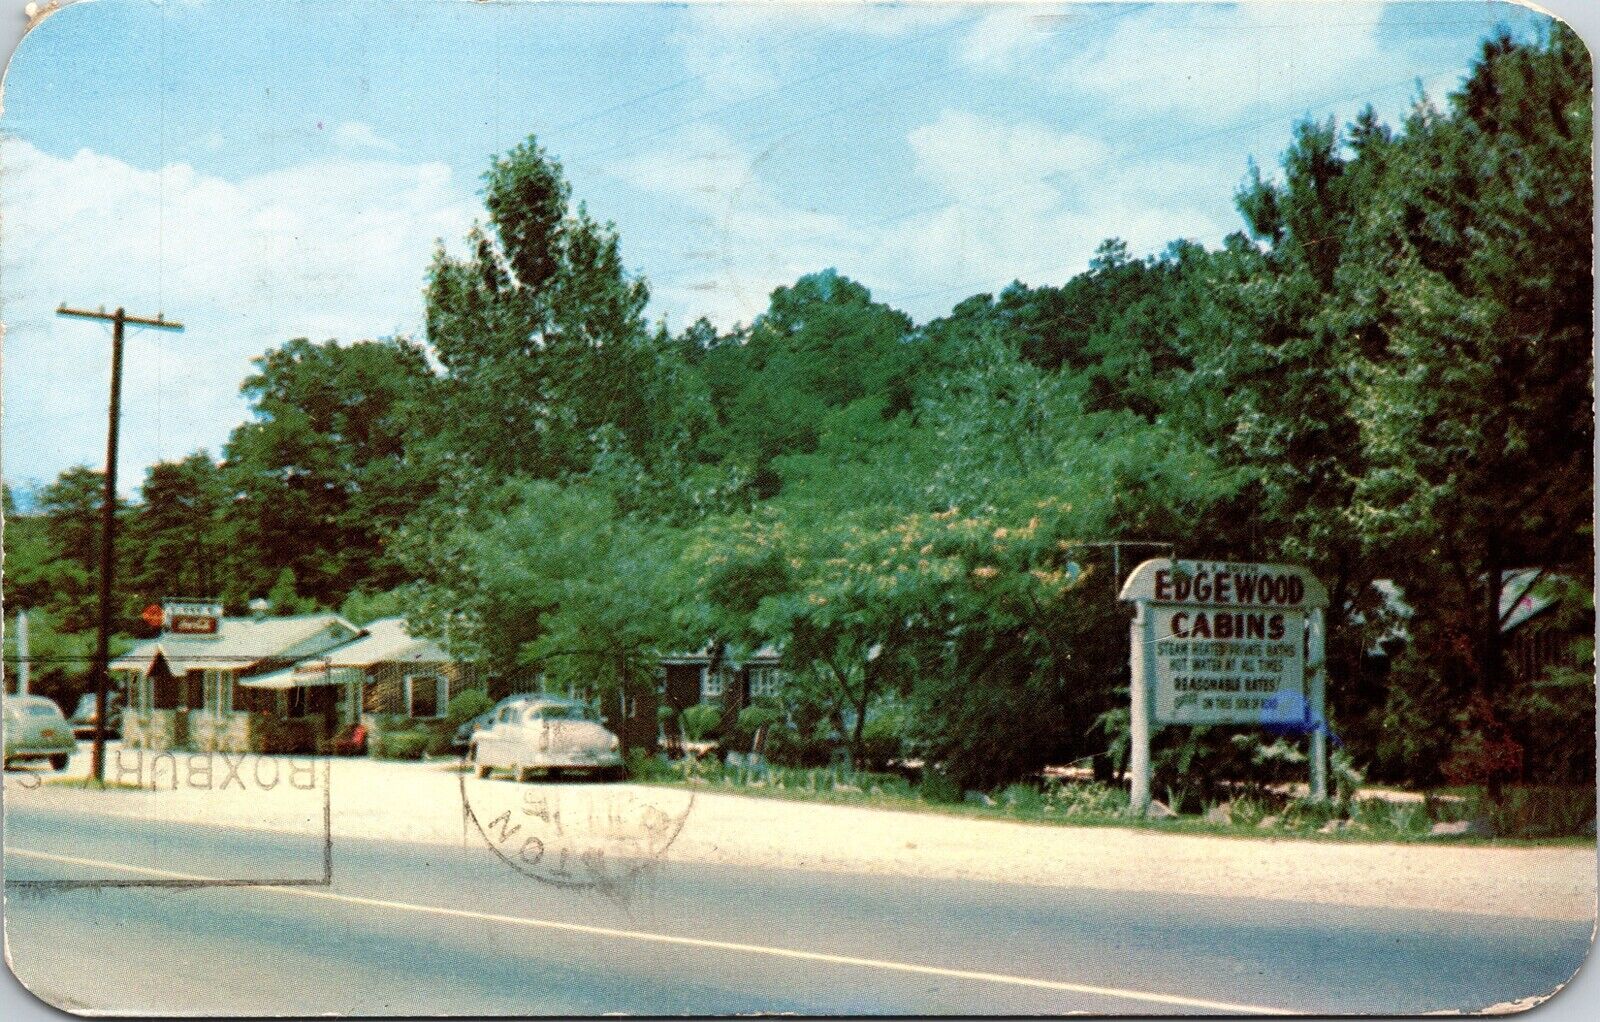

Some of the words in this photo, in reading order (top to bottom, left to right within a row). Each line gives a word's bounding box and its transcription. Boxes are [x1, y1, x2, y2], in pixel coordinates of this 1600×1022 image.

[1154, 569, 1305, 605] EDGEWOOD
[1171, 611, 1286, 640] CABINS
[1157, 641, 1189, 656] STEAM
[1173, 676, 1241, 691] REASONABLE
[84, 749, 316, 791] ROXBUR
